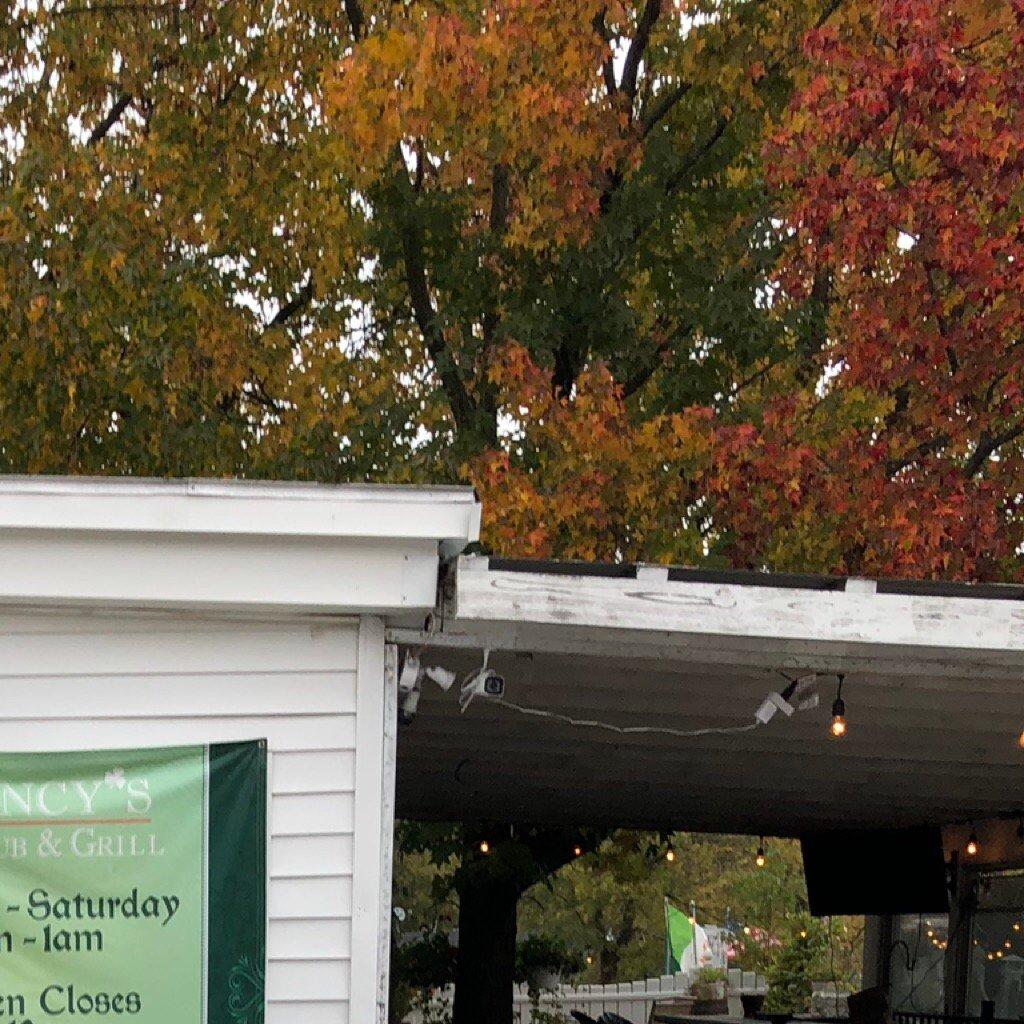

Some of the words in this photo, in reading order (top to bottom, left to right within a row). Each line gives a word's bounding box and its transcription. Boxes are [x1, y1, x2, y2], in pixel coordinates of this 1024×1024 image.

[37, 827, 62, 857] &
[70, 826, 165, 856] GRILL
[27, 888, 180, 927] Saturday
[43, 923, 103, 952] 1am
[39, 984, 141, 1016] Closes
